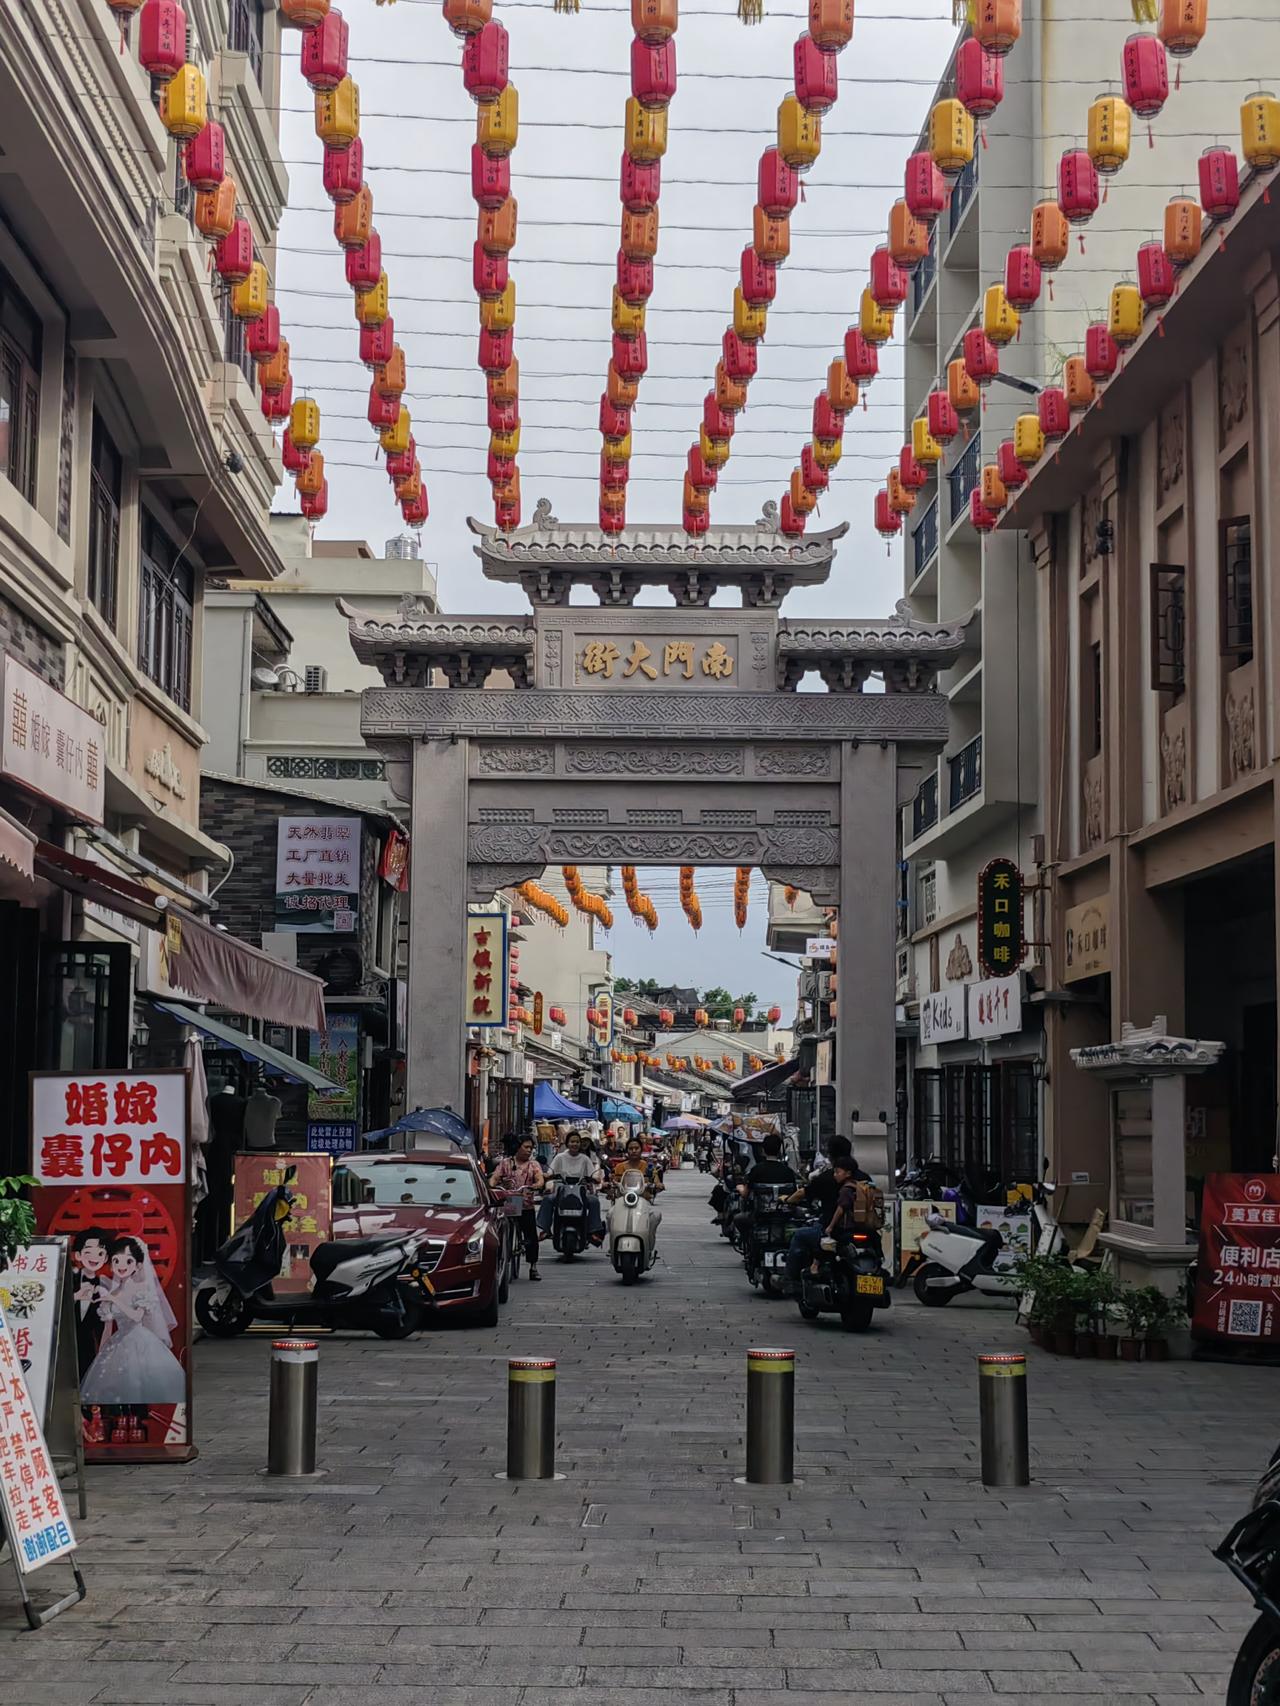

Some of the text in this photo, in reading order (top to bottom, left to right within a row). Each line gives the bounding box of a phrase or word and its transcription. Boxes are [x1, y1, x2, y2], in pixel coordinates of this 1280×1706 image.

[993, 873, 1011, 963] 禾口咖啡
[65, 1081, 157, 1126] 婚嫁
[1232, 1208, 1275, 1224] 美宜佳
[1220, 1245, 1280, 1269] 便利店
[22, 1521, 71, 1562] 谢谢配合
